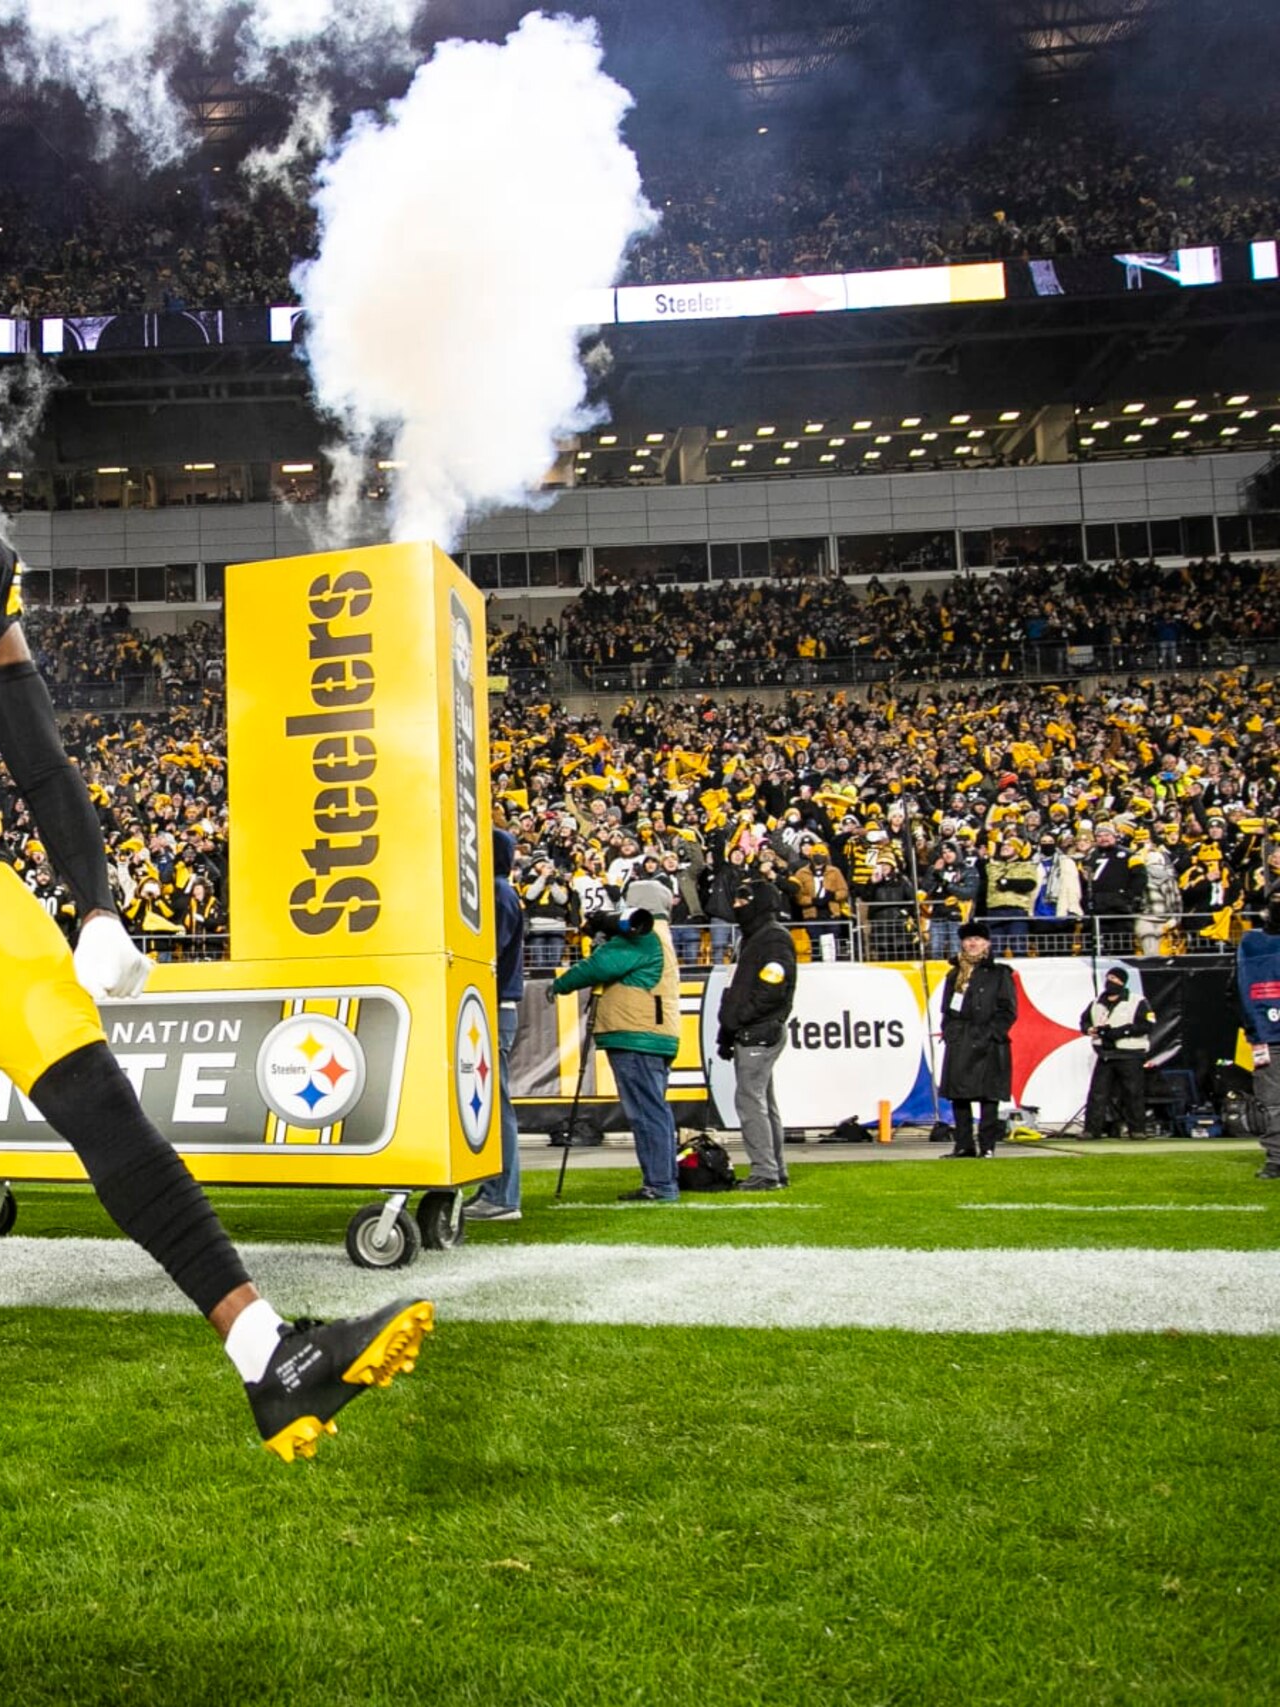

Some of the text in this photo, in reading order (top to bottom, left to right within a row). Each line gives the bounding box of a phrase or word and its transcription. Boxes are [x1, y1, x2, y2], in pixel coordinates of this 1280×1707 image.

[655, 291, 734, 314] Steelers
[285, 569, 381, 935] Steelers
[1093, 858, 1109, 881] 7
[584, 886, 605, 911] 55
[111, 1018, 243, 1045] NATION
[788, 1009, 905, 1050] teelers
[271, 1063, 307, 1075] Steelers
